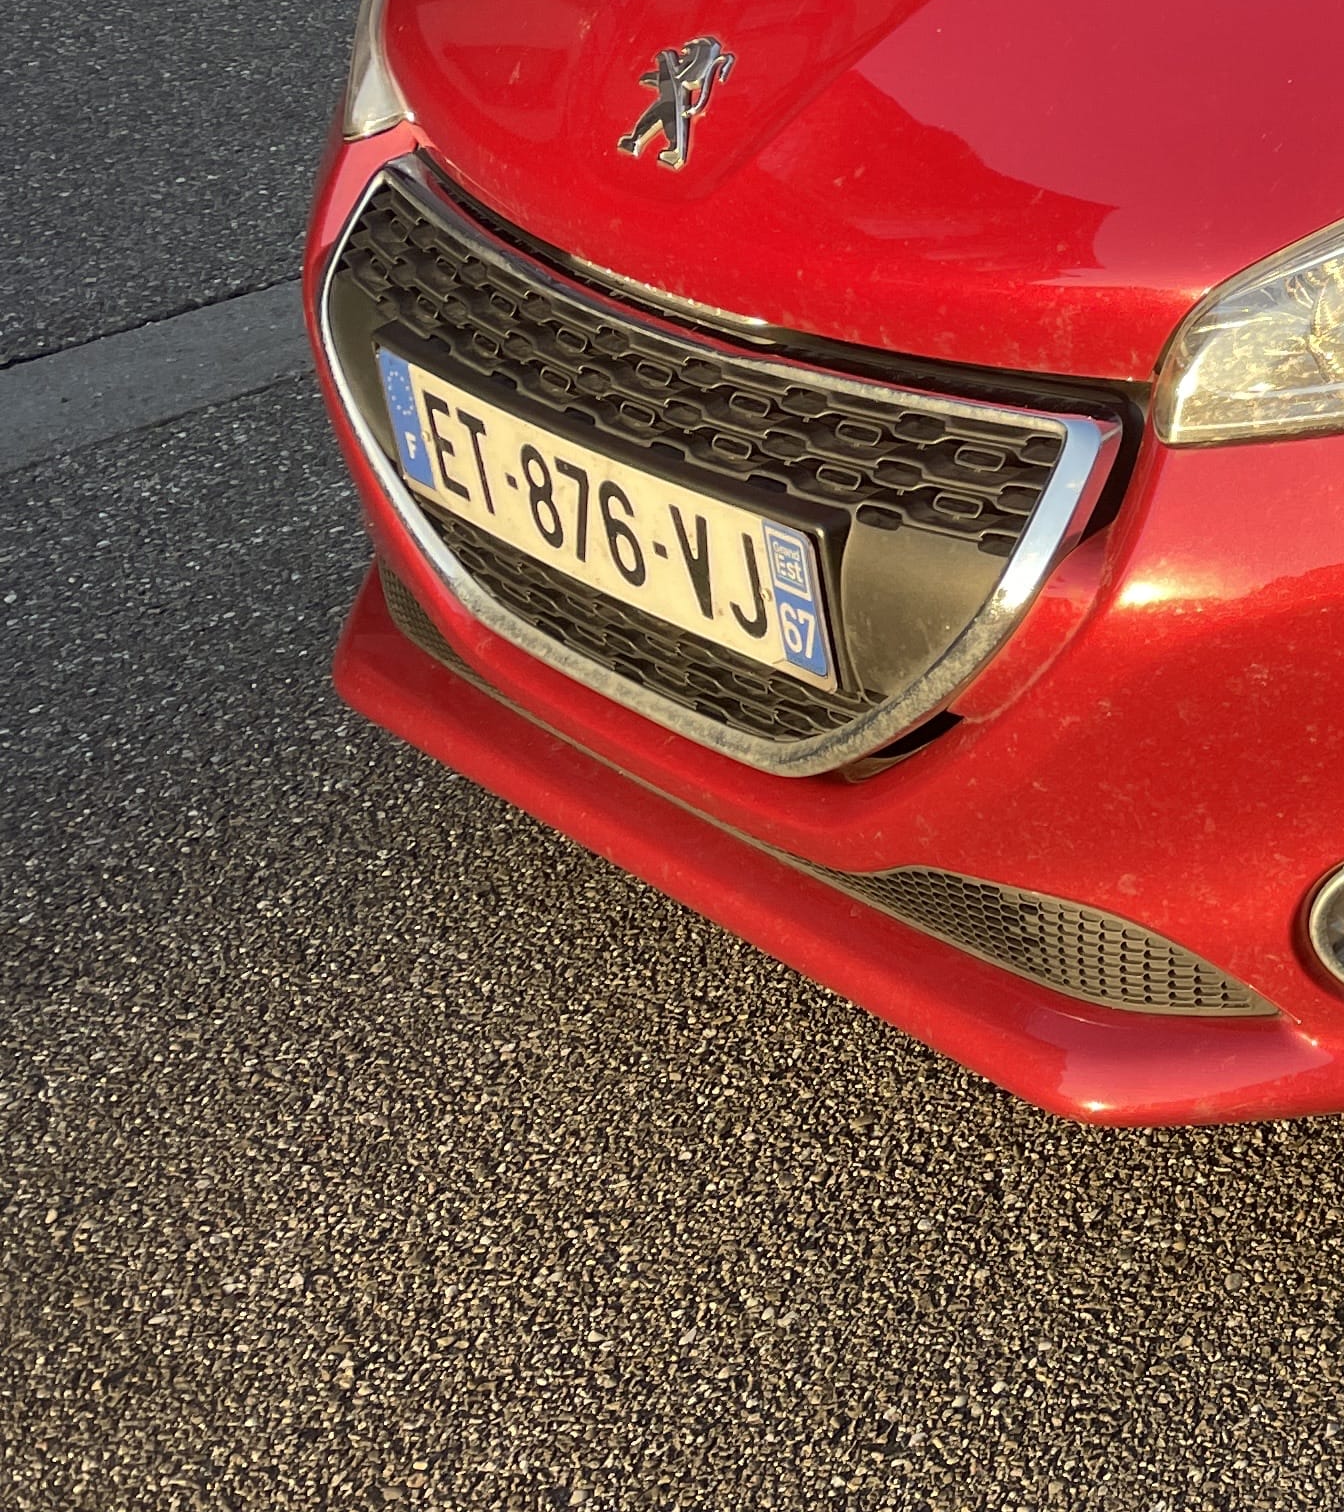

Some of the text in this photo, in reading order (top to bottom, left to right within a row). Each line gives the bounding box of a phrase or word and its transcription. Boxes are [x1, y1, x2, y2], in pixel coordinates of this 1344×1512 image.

[405, 431, 416, 460] F
[422, 390, 768, 639] ET-876-VJ
[775, 554, 803, 584] Est
[780, 602, 816, 659] 67
